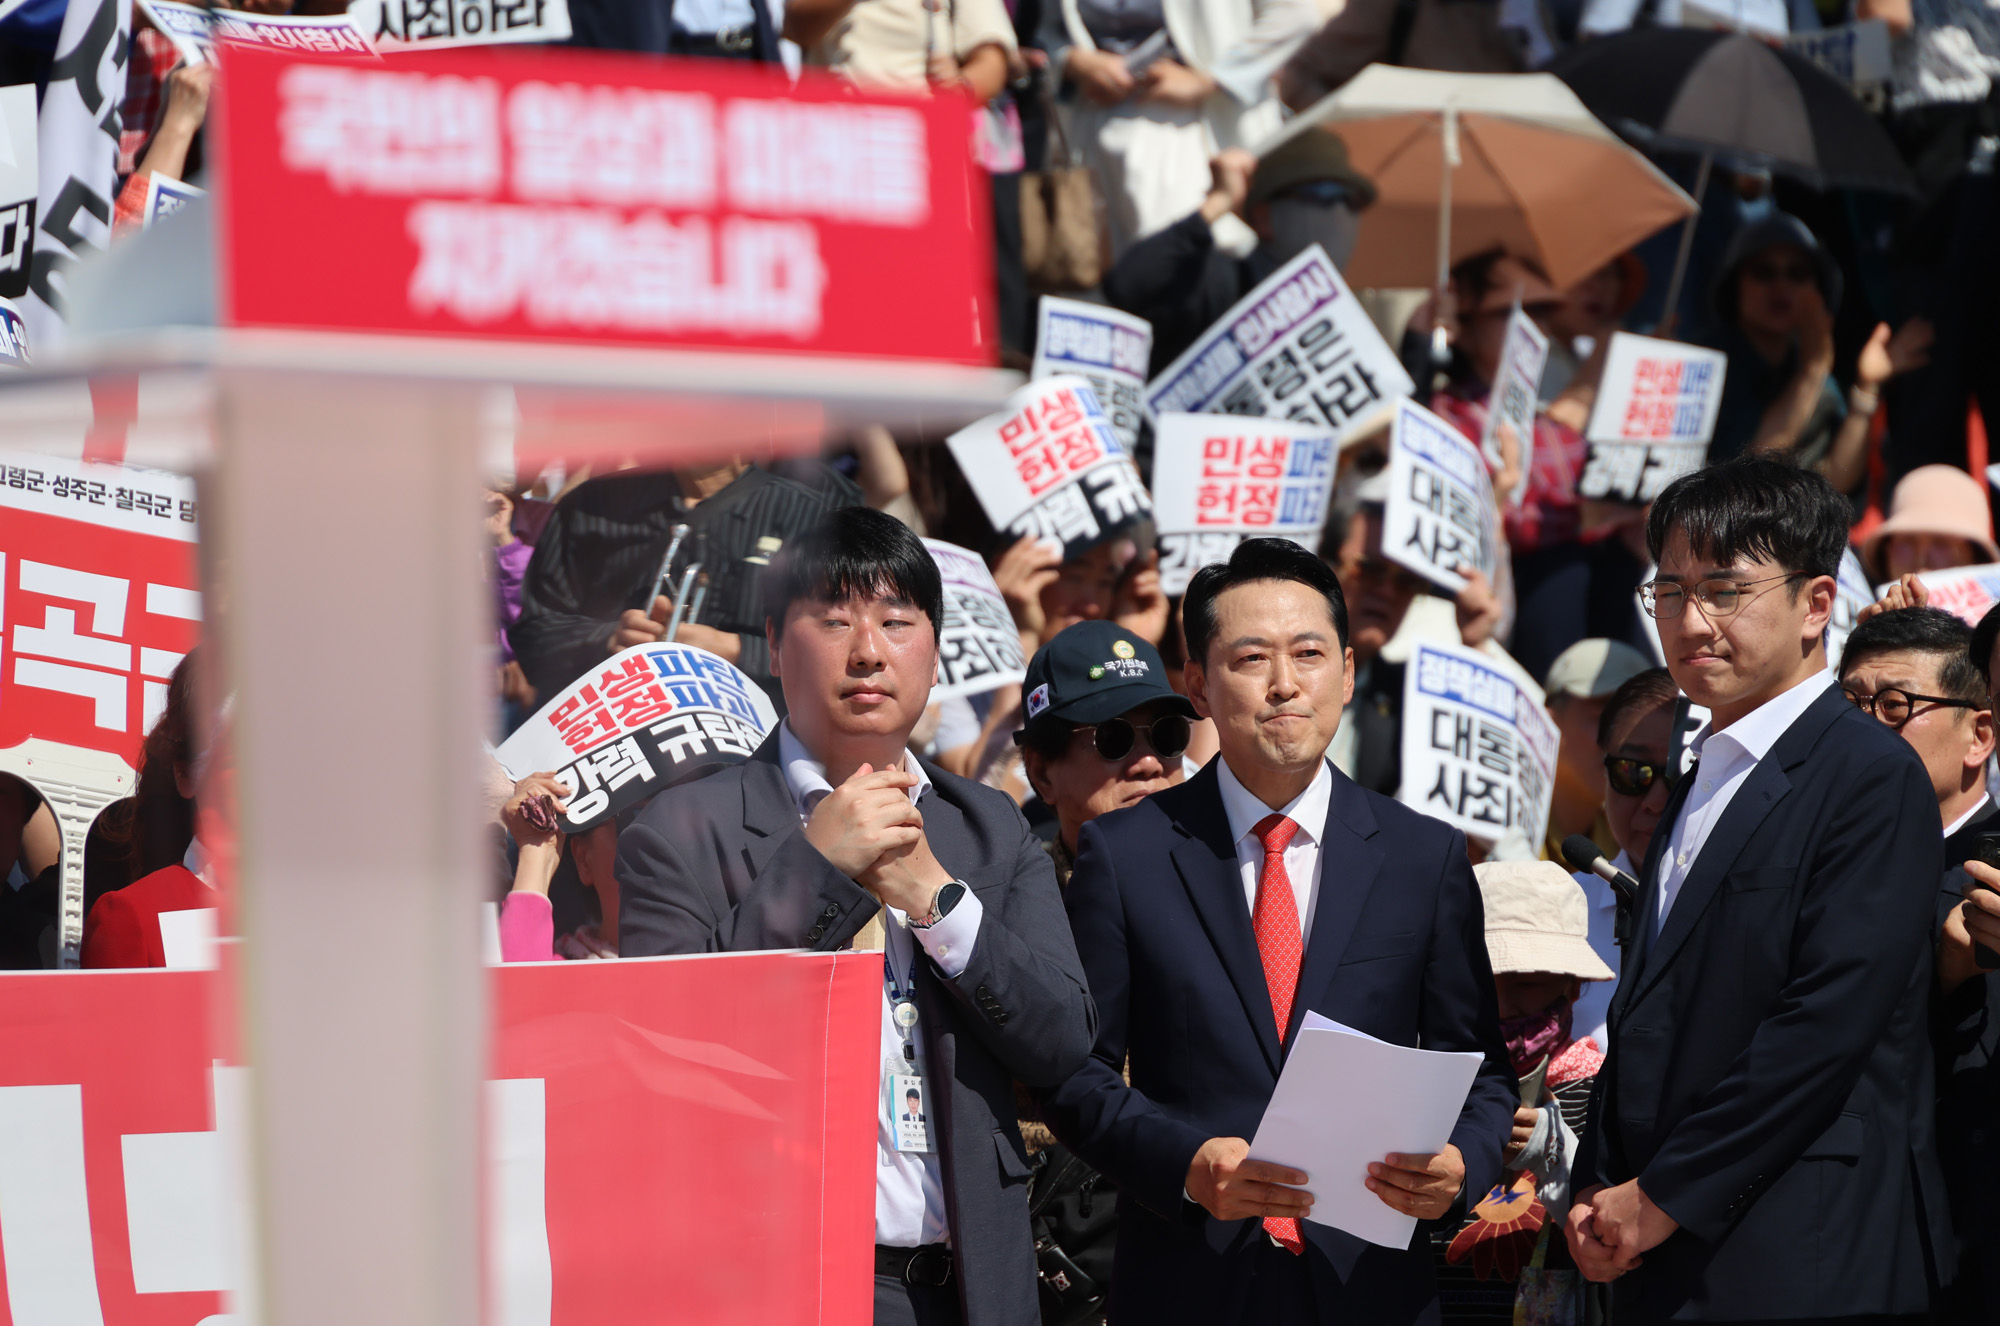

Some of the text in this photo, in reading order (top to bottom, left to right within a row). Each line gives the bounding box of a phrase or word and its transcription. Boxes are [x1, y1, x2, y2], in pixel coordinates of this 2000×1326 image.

[376, 0, 546, 43] 사죄하라
[279, 63, 502, 198] 국민의
[506, 80, 718, 207] 일상과
[724, 97, 930, 226] 미래를
[408, 200, 826, 341] 지키겠습니다
[548, 650, 746, 733] 민생파탄
[560, 680, 766, 755] 헌정파괴
[553, 712, 766, 825] 강력 규탄
